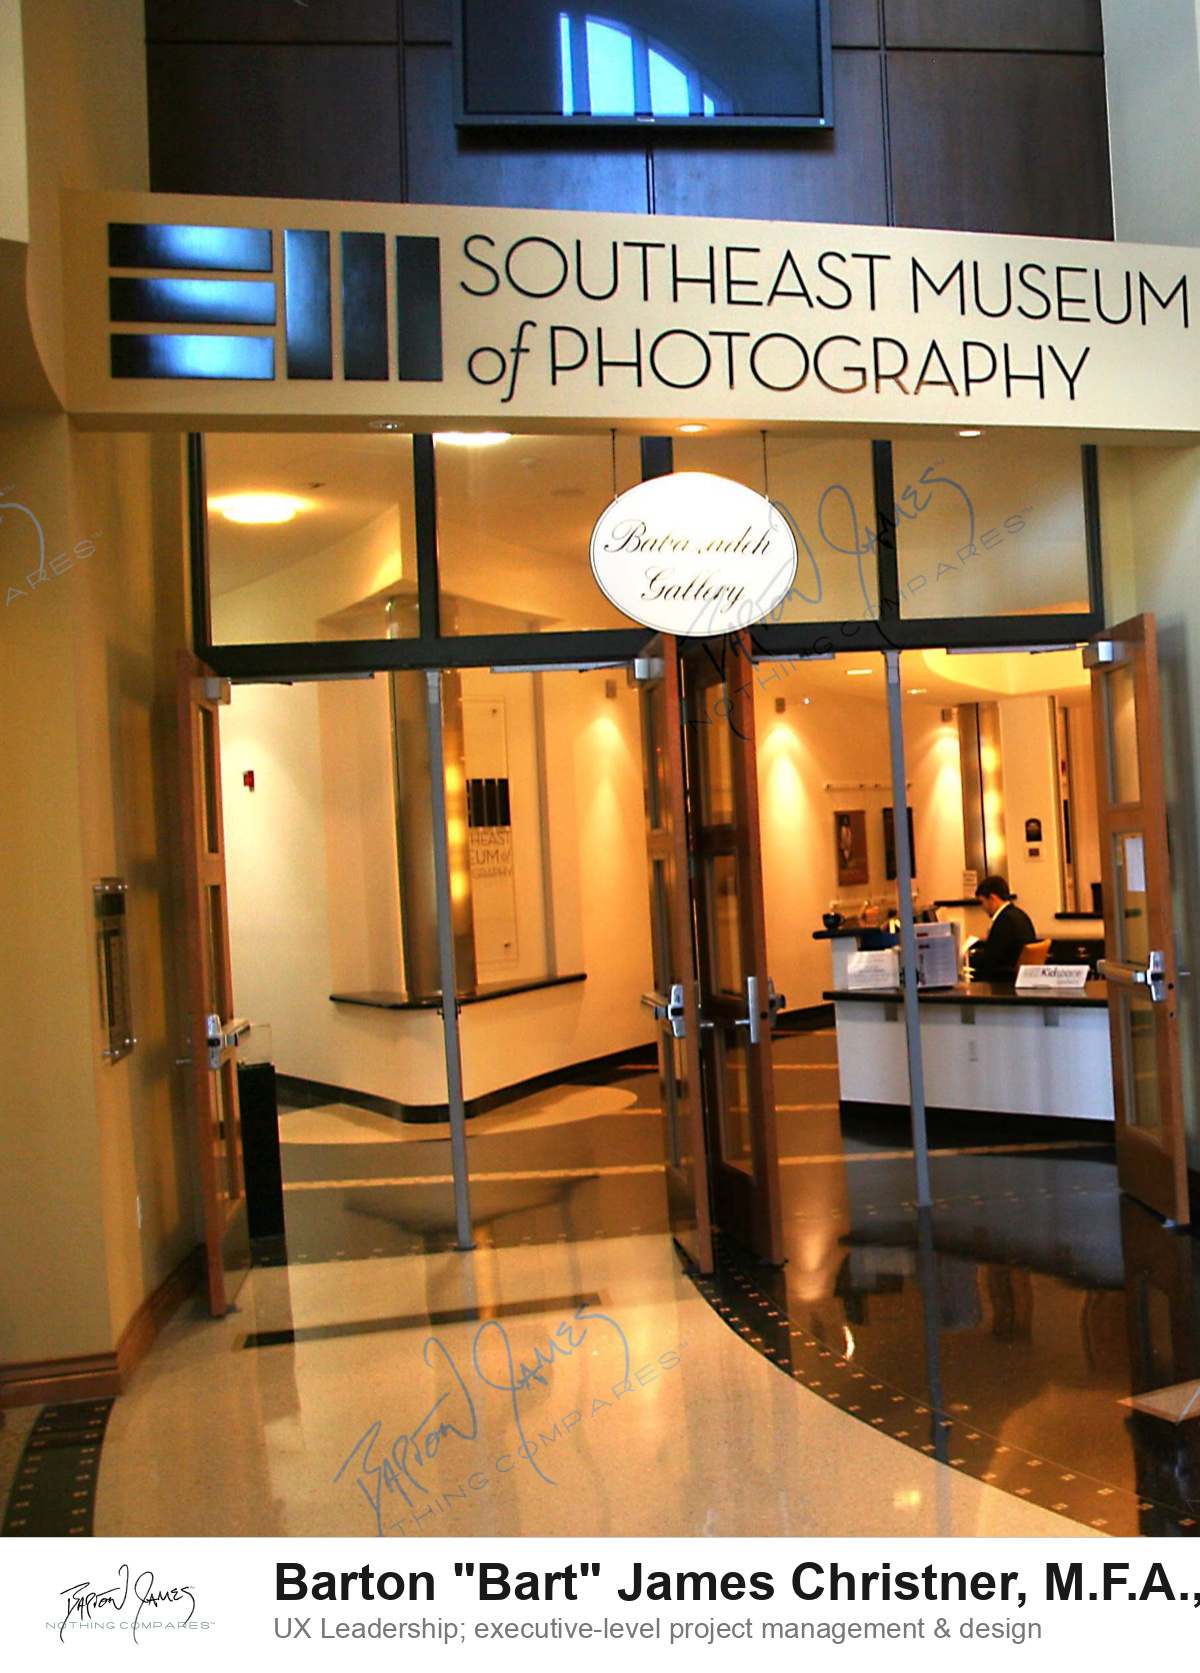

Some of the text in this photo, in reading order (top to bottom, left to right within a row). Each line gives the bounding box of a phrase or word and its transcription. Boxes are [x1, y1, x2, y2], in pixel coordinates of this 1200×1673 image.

[460, 233, 1190, 329] SOUTHEAST MUSEUM
[467, 319, 1092, 403] of PHOTOGRAPHY
[603, 518, 771, 556] Babaadeh
[640, 565, 745, 615] Gallery
[470, 830, 511, 847] HEAST
